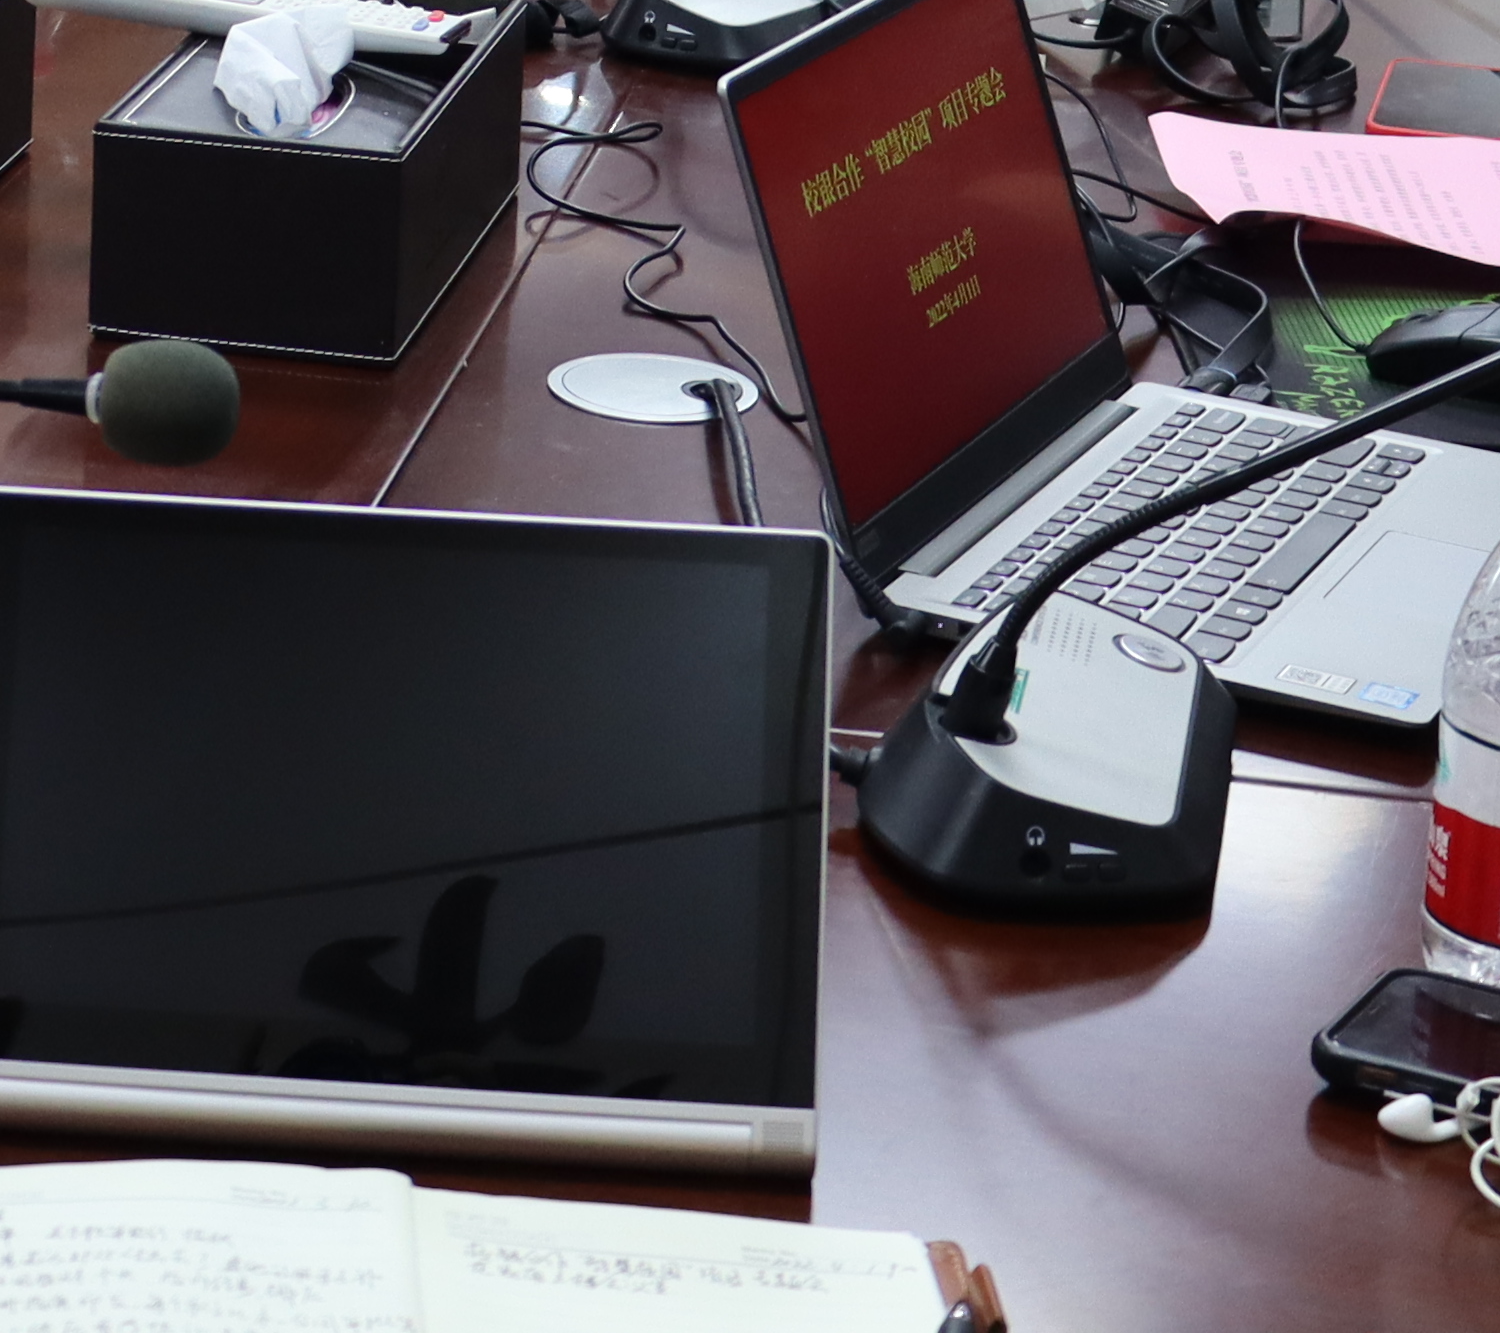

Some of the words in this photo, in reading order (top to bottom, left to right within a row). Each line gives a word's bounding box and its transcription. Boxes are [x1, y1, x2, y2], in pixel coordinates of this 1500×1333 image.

[906, 226, 977, 296] 海南师范大学
